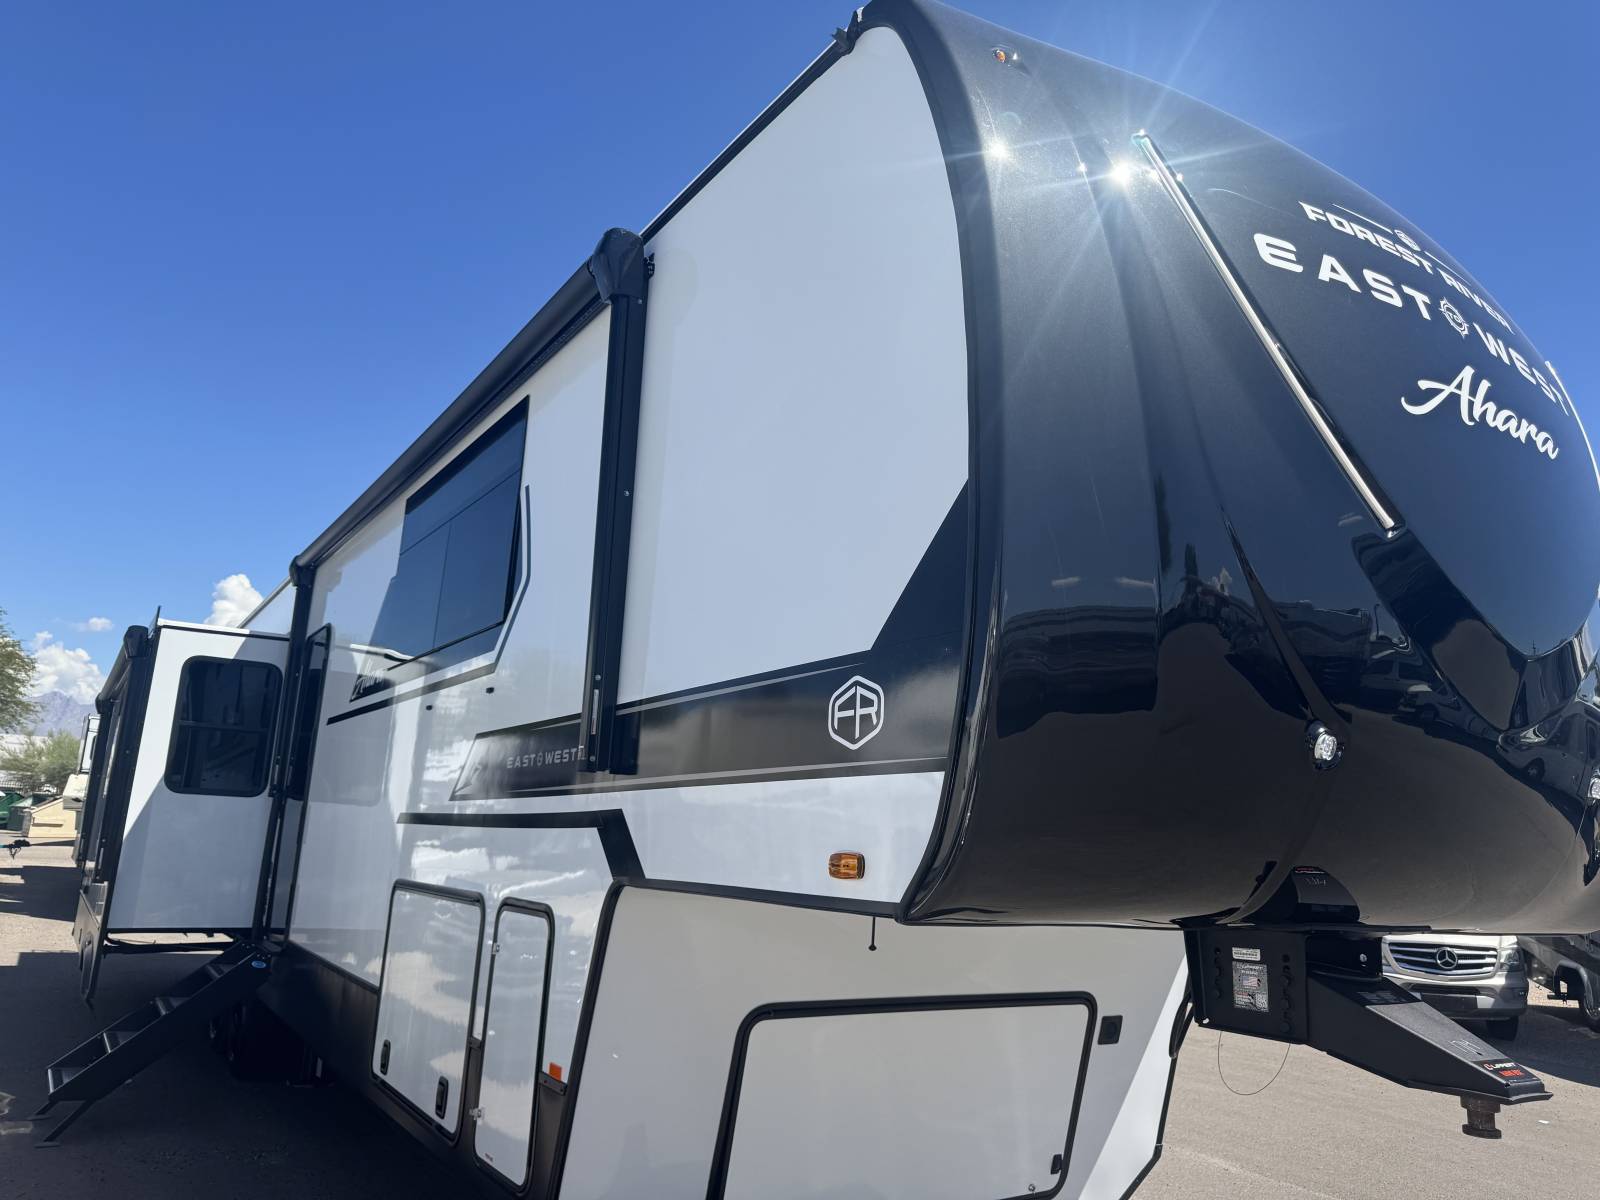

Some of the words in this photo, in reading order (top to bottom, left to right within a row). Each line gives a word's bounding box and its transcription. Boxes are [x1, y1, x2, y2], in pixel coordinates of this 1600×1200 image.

[1253, 233, 1433, 321] EAST
[1473, 322, 1569, 417] WEST
[1298, 201, 1434, 275] FOREST
[1437, 268, 1516, 336] RIVER
[1400, 365, 1560, 461] Ahara
[506, 754, 537, 769] EAST
[544, 747, 578, 765] WEST
